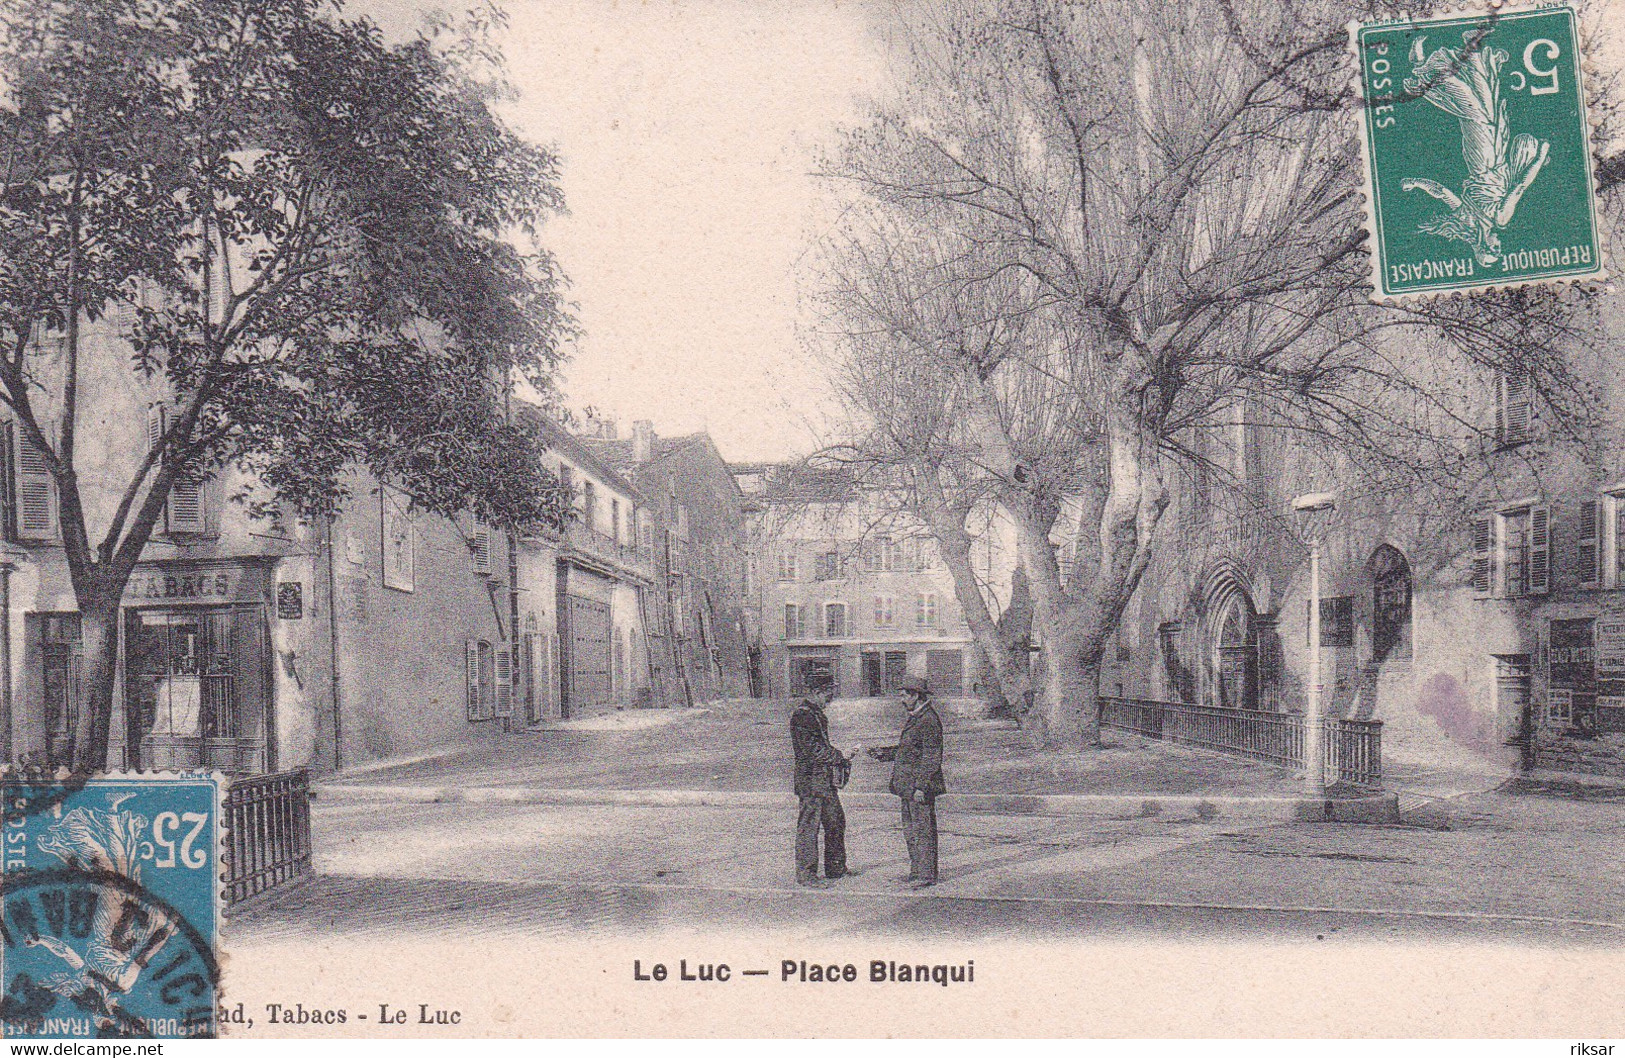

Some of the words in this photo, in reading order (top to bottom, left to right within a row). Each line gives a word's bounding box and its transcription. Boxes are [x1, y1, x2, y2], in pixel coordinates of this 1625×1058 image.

[1370, 42, 1396, 130] POSTES
[1391, 257, 1475, 283] FRANÇAISE
[130, 573, 229, 598] TABACS
